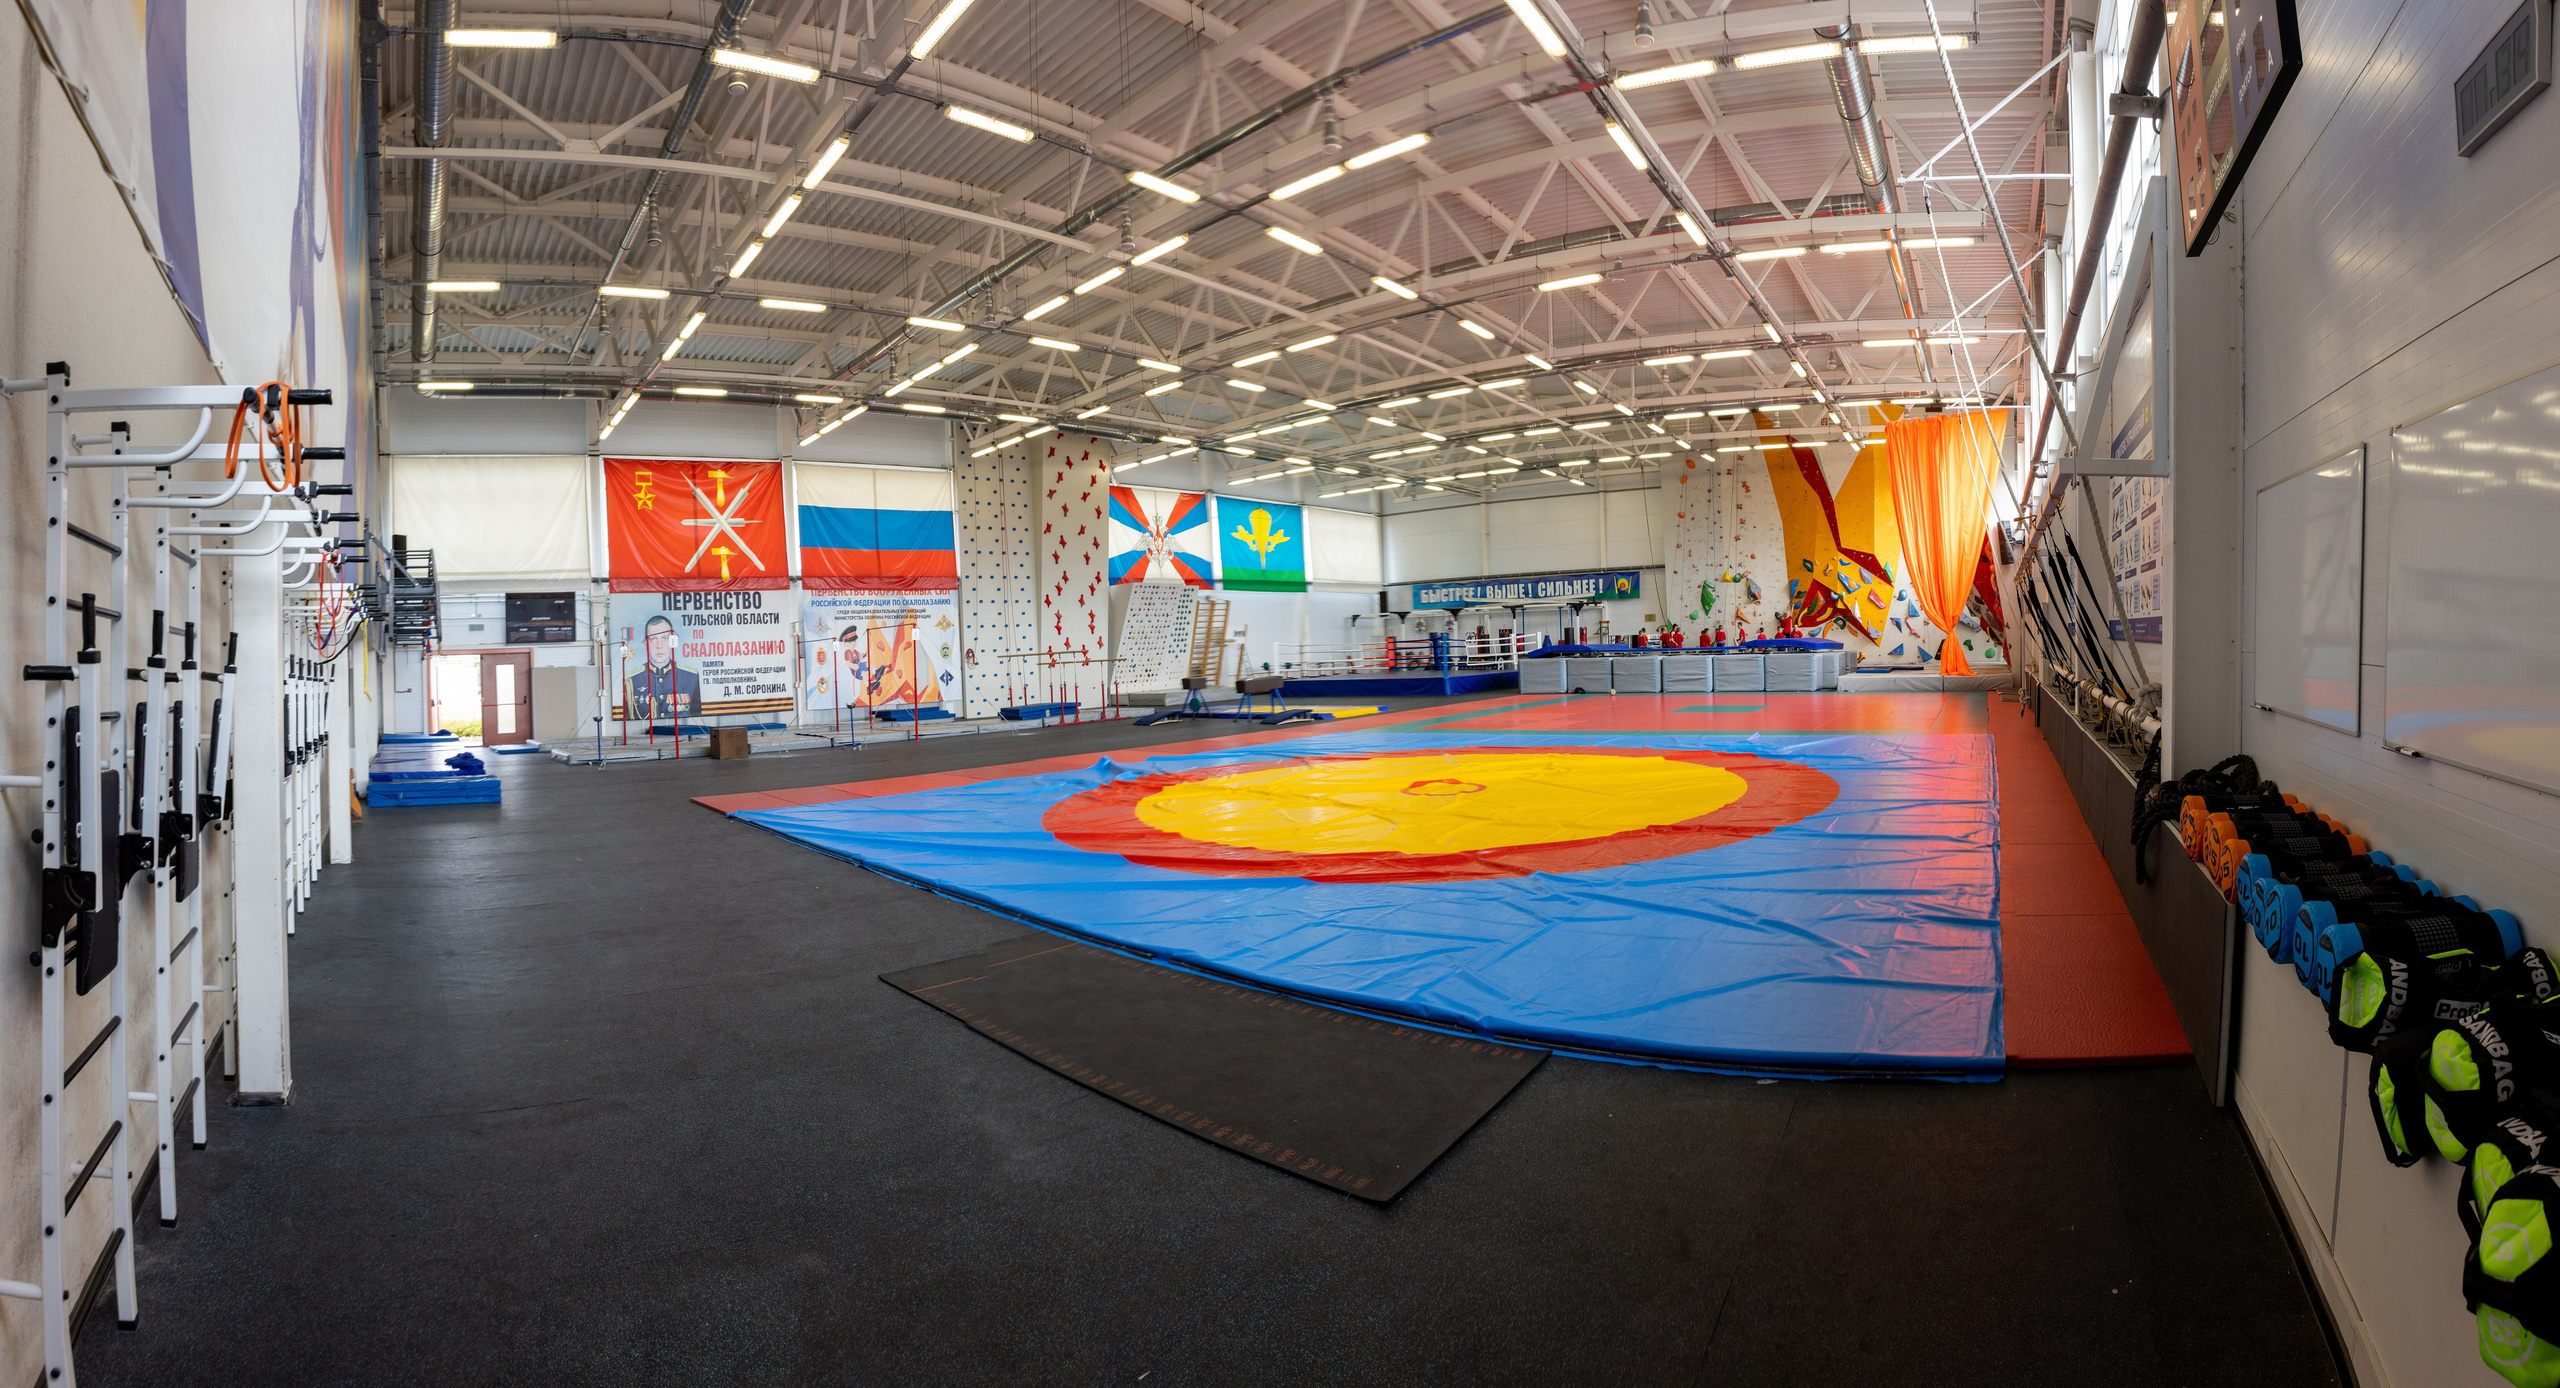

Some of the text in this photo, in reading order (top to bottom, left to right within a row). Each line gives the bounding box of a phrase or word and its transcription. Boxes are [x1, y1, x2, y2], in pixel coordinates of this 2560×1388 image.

[662, 591, 762, 611] ПЕРВЕНСТВО
[811, 598, 852, 608] РОССИЙСКОЙ
[853, 598, 891, 607] ФЕДЕРАЦИИ
[902, 598, 951, 606] СКАЛОЛАЗАНИЮ
[682, 612, 780, 627] ТУЛЬСКОЙ ОБЛАСТИ
[692, 629, 704, 640] ПО
[681, 639, 786, 658] СКАЛОЛАЗАНИЮ
[702, 660, 724, 668] ПАМЯТИ
[702, 666, 786, 677] ГЕРОЯ РОССИЙСКОЙ ФЕДЕРАЦИИ
[703, 676, 757, 685] ГВ. ПОДПОЛКОВНИКА
[723, 683, 787, 698] Д. М. СОРОКИНА
[2265, 910, 2277, 937] 10
[2294, 931, 2309, 962] 10
[2488, 1315, 2522, 1348] 33
